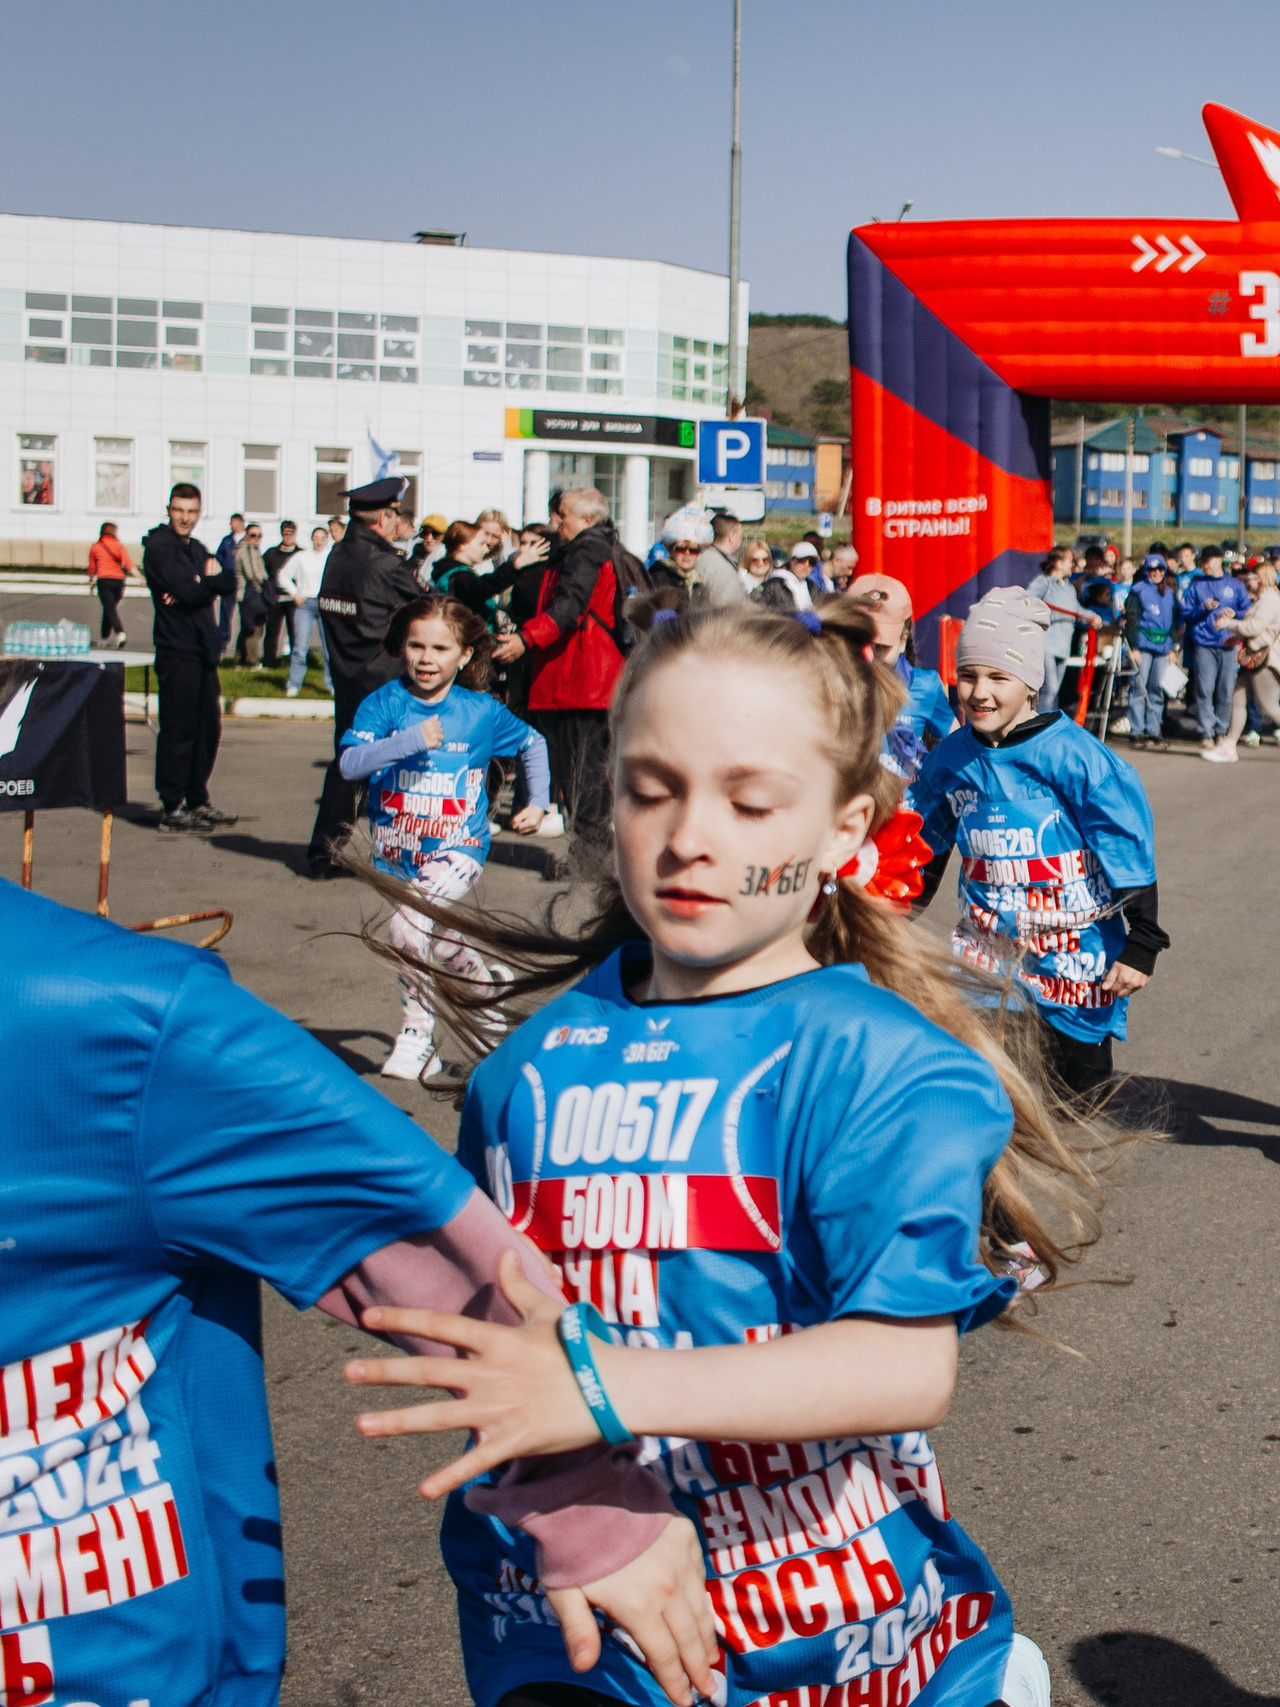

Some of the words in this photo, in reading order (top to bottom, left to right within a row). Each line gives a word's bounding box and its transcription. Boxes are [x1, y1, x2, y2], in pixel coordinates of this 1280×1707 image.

[716, 429, 752, 478] P
[865, 496, 882, 517] В
[883, 498, 943, 519] ритме
[944, 493, 988, 514] всей
[883, 516, 971, 539] СТРАНЫ!
[319, 596, 358, 617] ПОЛИЦИЯ
[398, 768, 456, 796] 00505
[403, 792, 444, 817] 500М
[969, 827, 1037, 858] 00526
[984, 858, 1030, 886] 500М
[550, 1078, 719, 1167] 00517
[561, 1172, 689, 1250] 500М
[0, 1393, 162, 1528] 2024
